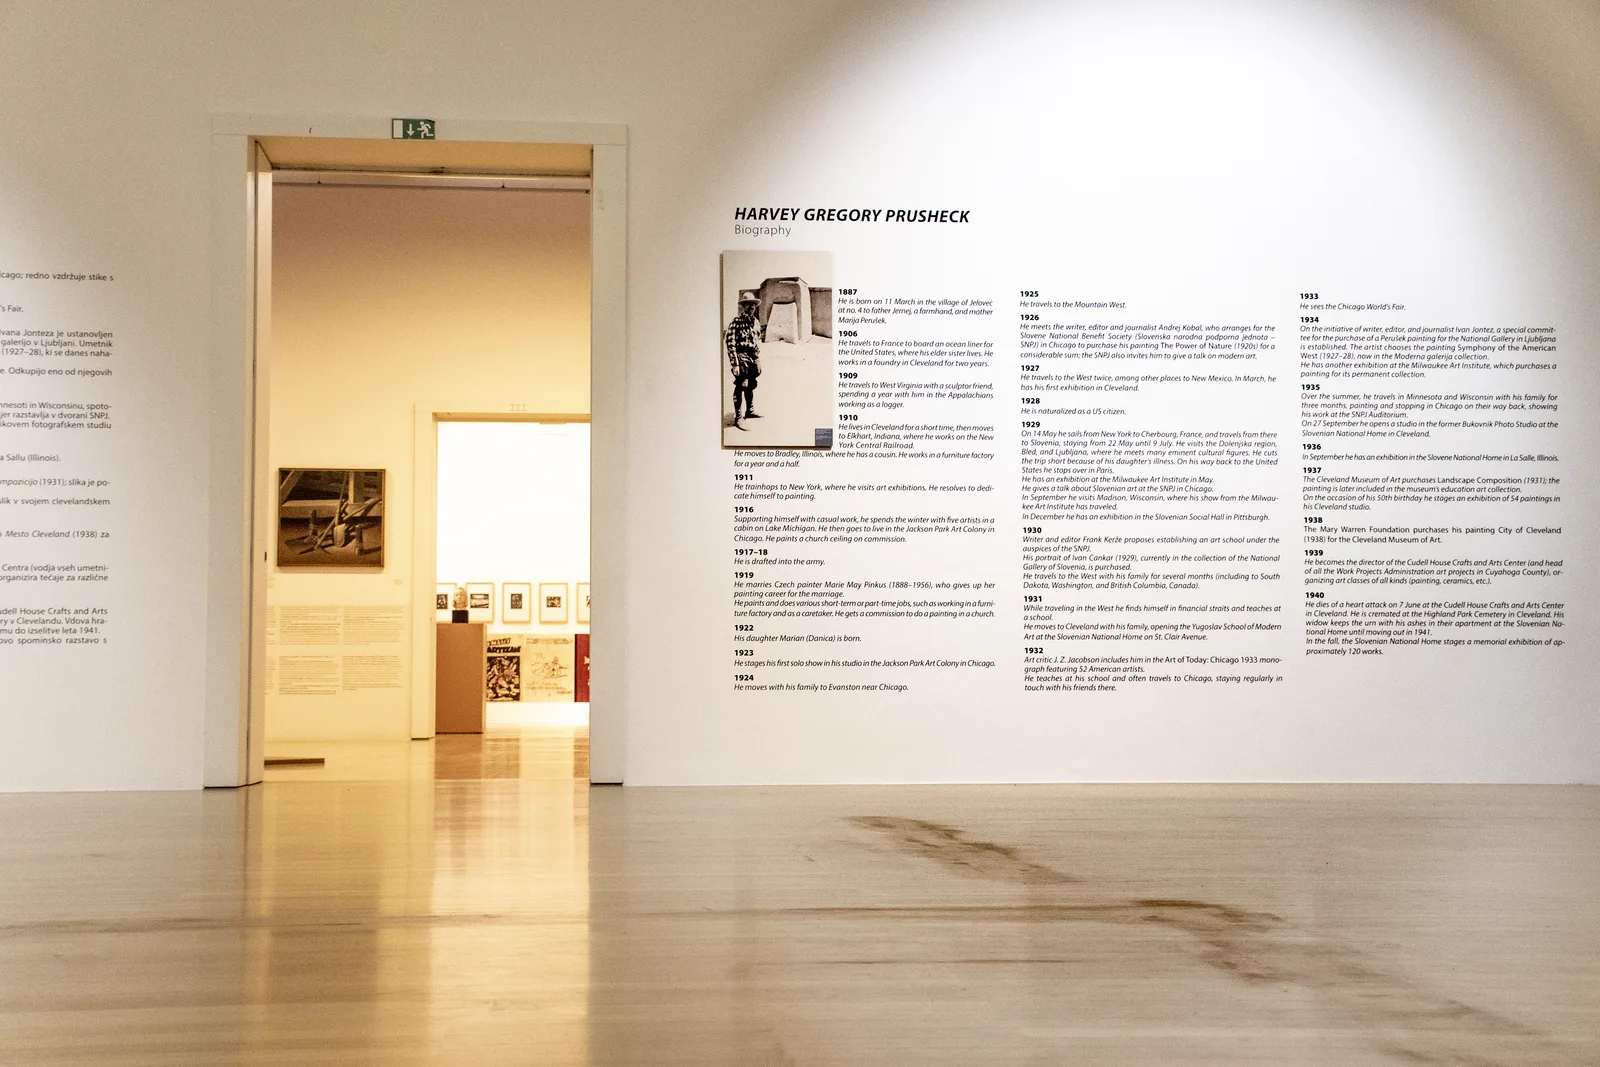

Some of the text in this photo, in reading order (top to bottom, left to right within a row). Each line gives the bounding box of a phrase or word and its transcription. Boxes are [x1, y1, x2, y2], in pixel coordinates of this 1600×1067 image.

[734, 207, 970, 223] HARVEY GREGORY PRUSHECK
[734, 224, 791, 237] Biography
[937, 299, 959, 307] village
[1337, 303, 1365, 312] Chicago
[838, 316, 887, 325] Marija Perušek.
[1108, 333, 1132, 341] Society
[1241, 334, 1268, 342] jednota
[0, 339, 31, 347] galerijo
[40, 339, 77, 348] Ljubljani.
[12, 412, 49, 420] razstavlja
[72, 531, 97, 539] (1938)
[1319, 526, 1338, 534] Mary
[1413, 526, 1448, 534] purchases
[1465, 527, 1495, 535] painting
[1498, 527, 1512, 535] City
[30, 565, 55, 573] (vodja
[733, 634, 745, 642] His
[745, 634, 778, 643] daughter
[1305, 648, 1347, 656] proximately
[1183, 675, 1213, 683] Chicago,
[1216, 675, 1241, 683] staying
[1243, 675, 1274, 683] regularly
